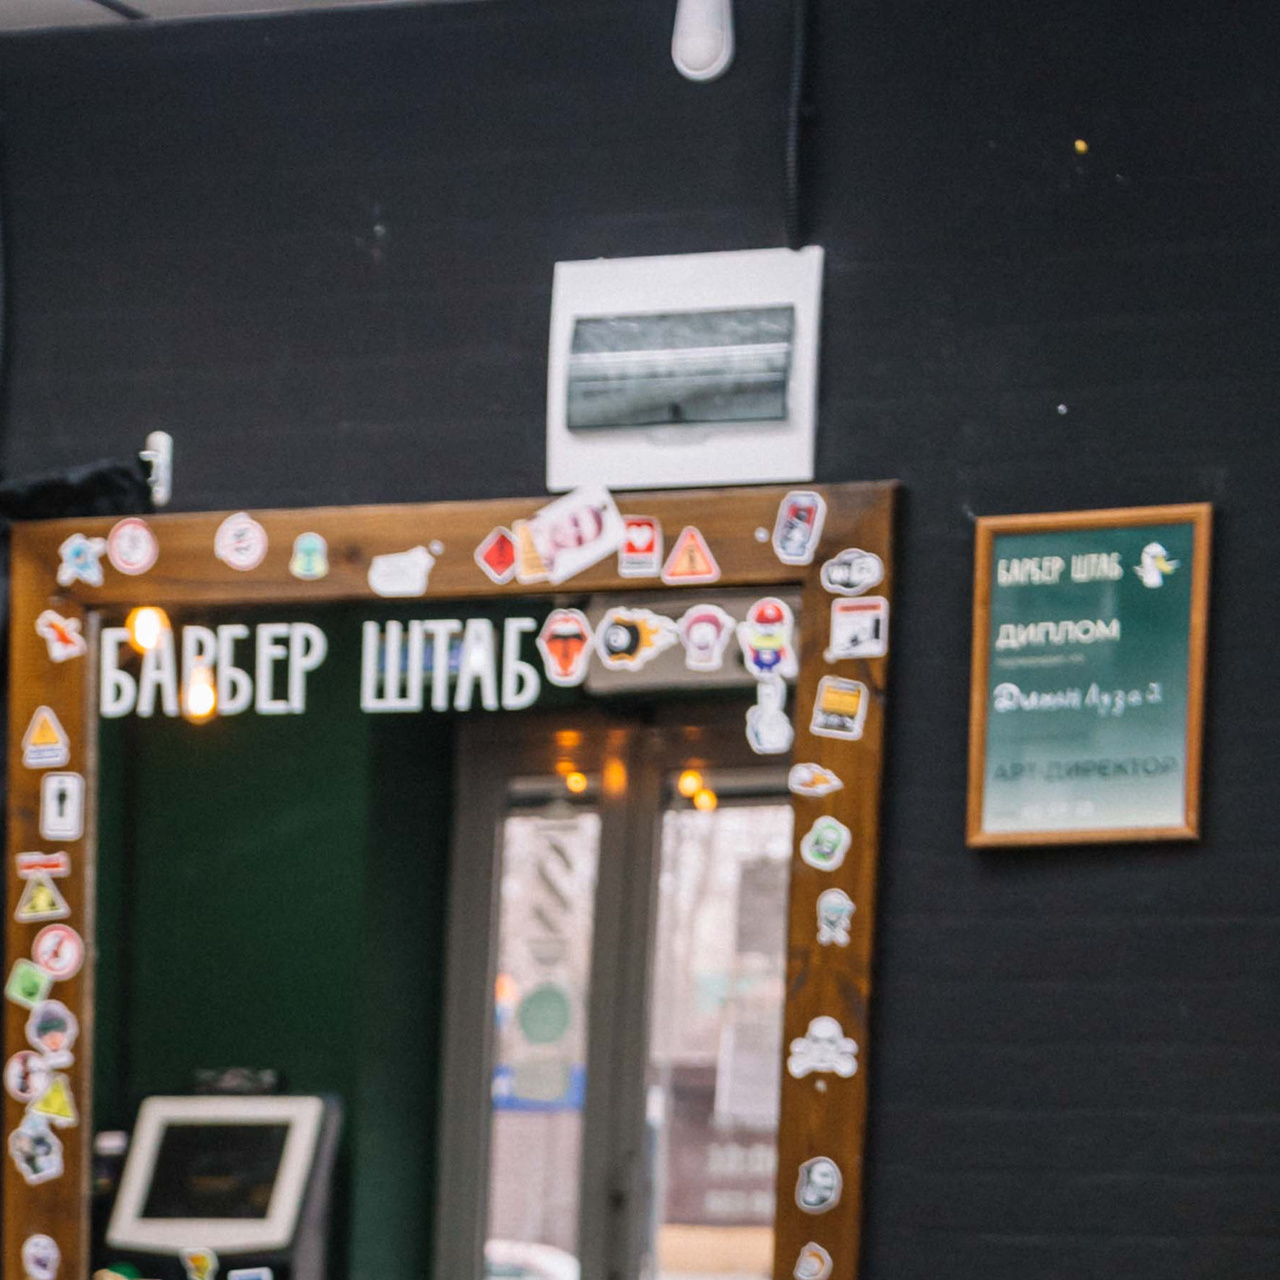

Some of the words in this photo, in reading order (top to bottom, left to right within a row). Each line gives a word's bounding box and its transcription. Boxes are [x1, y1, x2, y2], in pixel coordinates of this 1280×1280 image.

[998, 556, 1065, 587] БАРБЕР
[1071, 552, 1124, 582] ШТАБ
[995, 618, 1121, 650] ДИПЛОМ
[100, 622, 328, 718] БАРБЕР
[361, 617, 540, 712] ШТАБ
